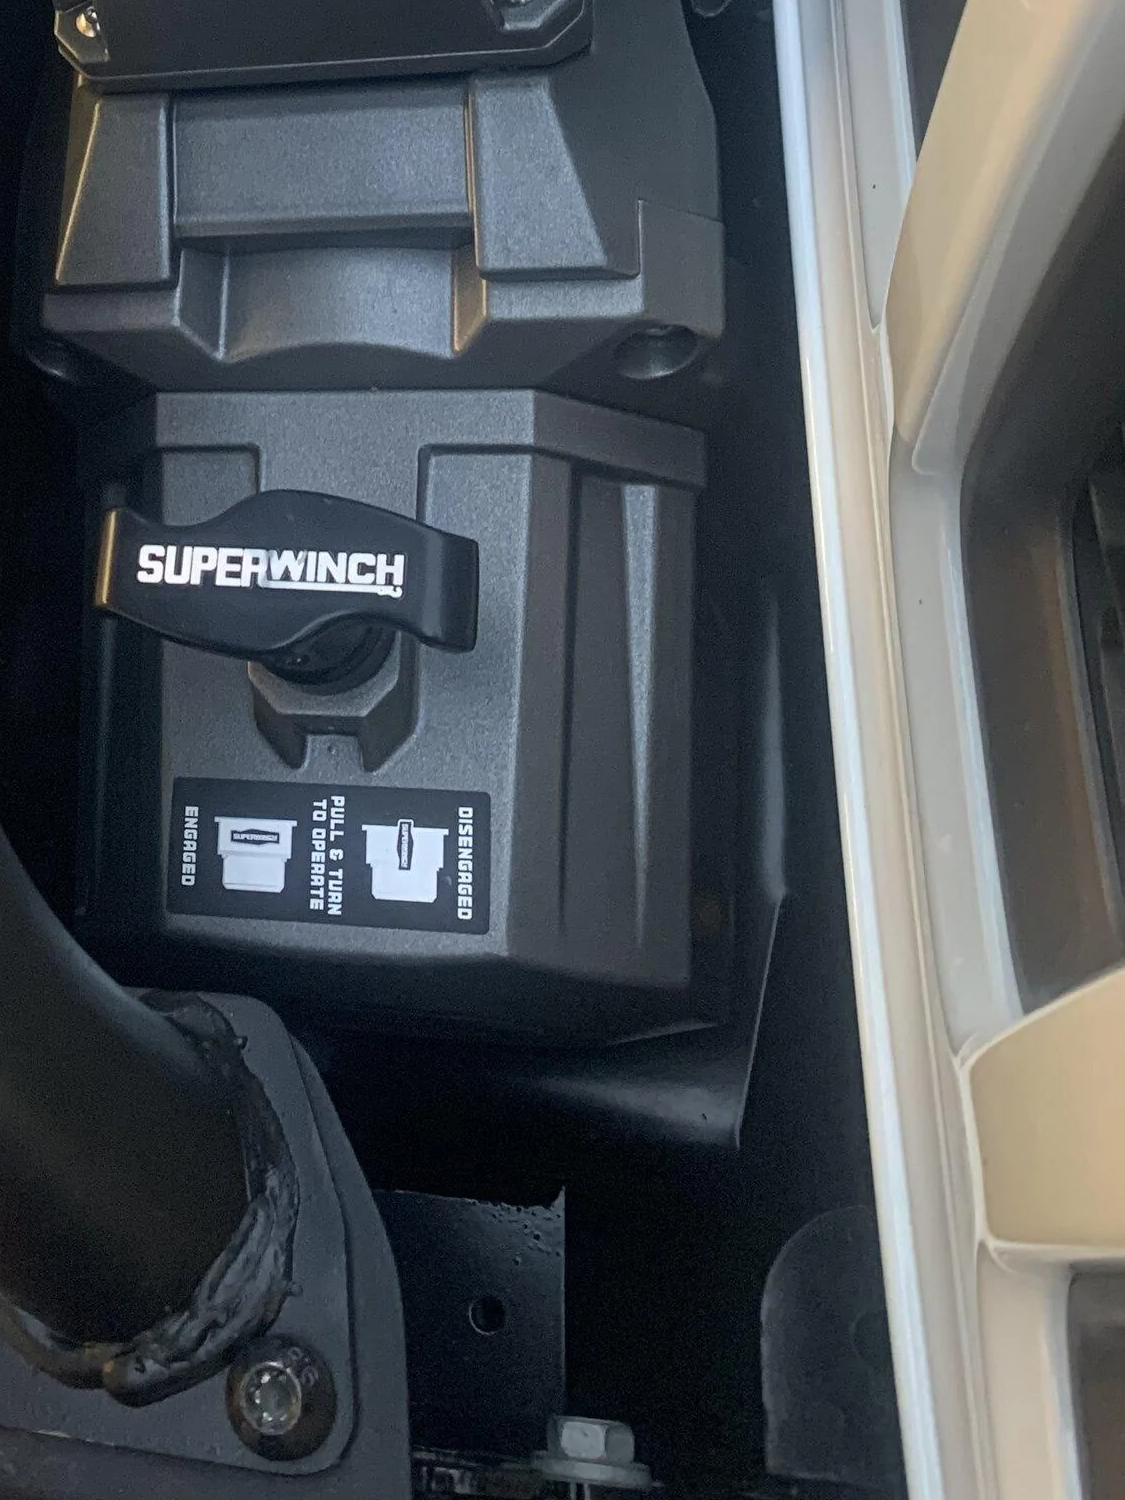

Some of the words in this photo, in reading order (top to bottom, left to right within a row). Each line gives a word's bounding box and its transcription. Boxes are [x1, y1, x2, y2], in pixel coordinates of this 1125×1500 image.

[136, 544, 406, 598] SUPERWINCH
[312, 798, 327, 821] TO
[329, 795, 346, 841] PULL
[180, 805, 200, 887] ENGAGED
[309, 827, 327, 911] OPERATE
[329, 847, 344, 862] &
[457, 806, 474, 921] DISENGAGED
[327, 868, 344, 916] TURN
